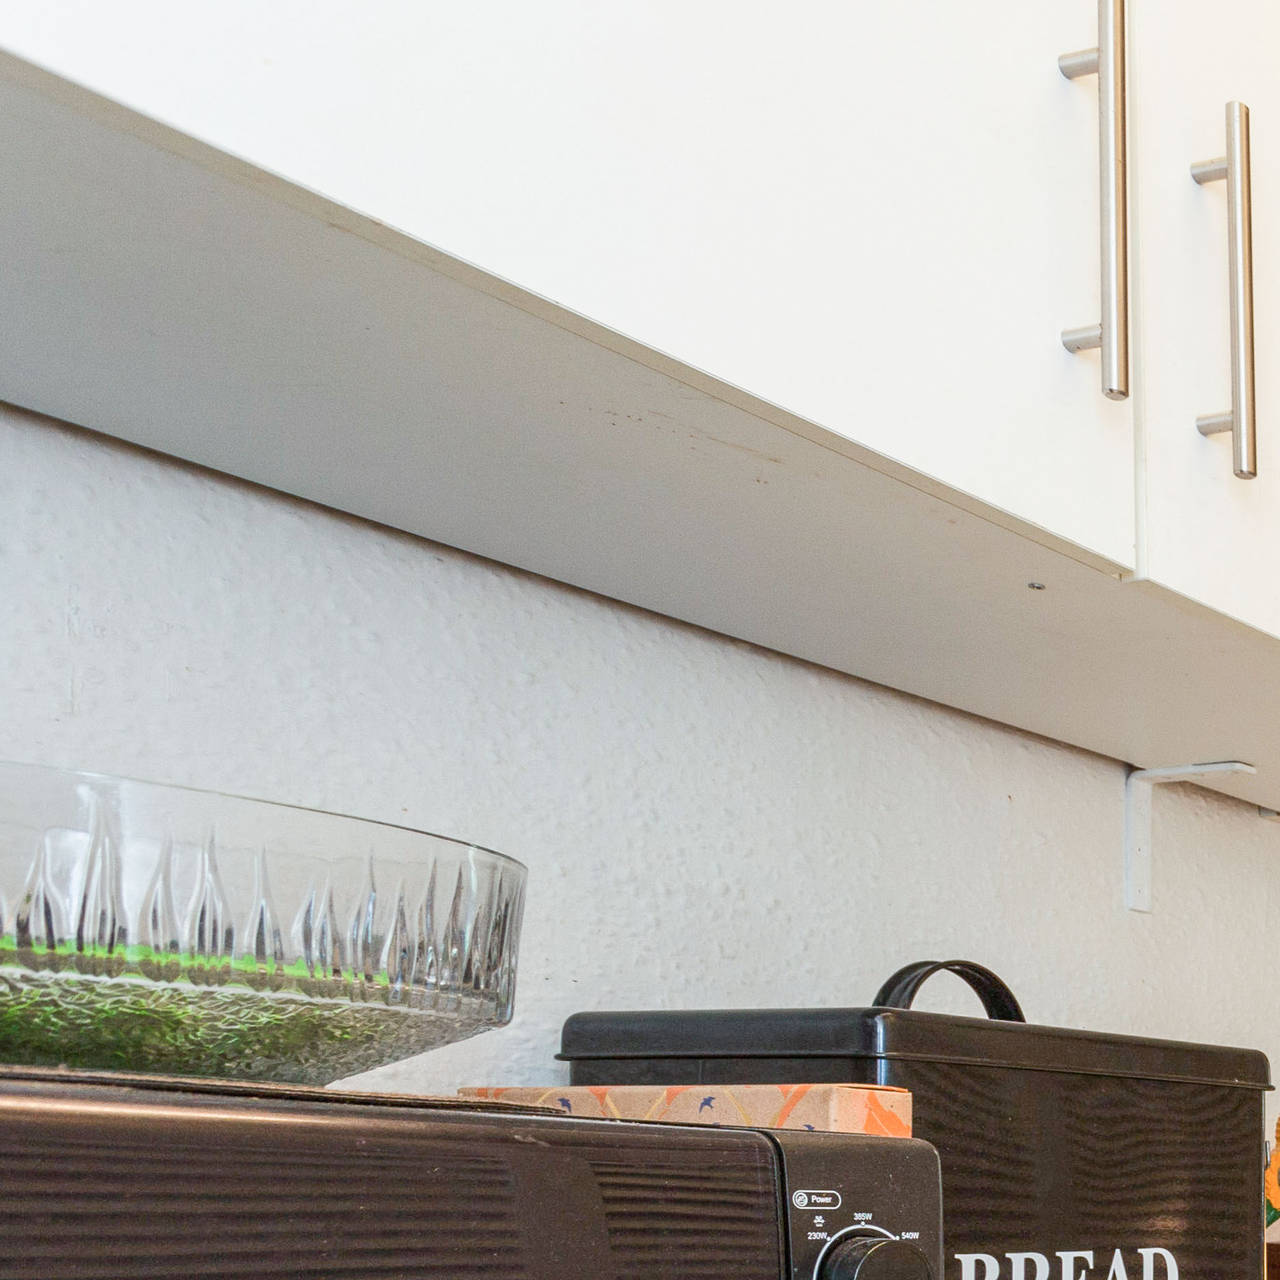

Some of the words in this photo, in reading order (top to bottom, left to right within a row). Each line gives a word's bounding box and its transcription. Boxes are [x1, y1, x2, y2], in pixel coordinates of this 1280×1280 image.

[811, 1195, 832, 1204] Power
[807, 1232, 827, 1240] 230W
[901, 1232, 919, 1240] 540W
